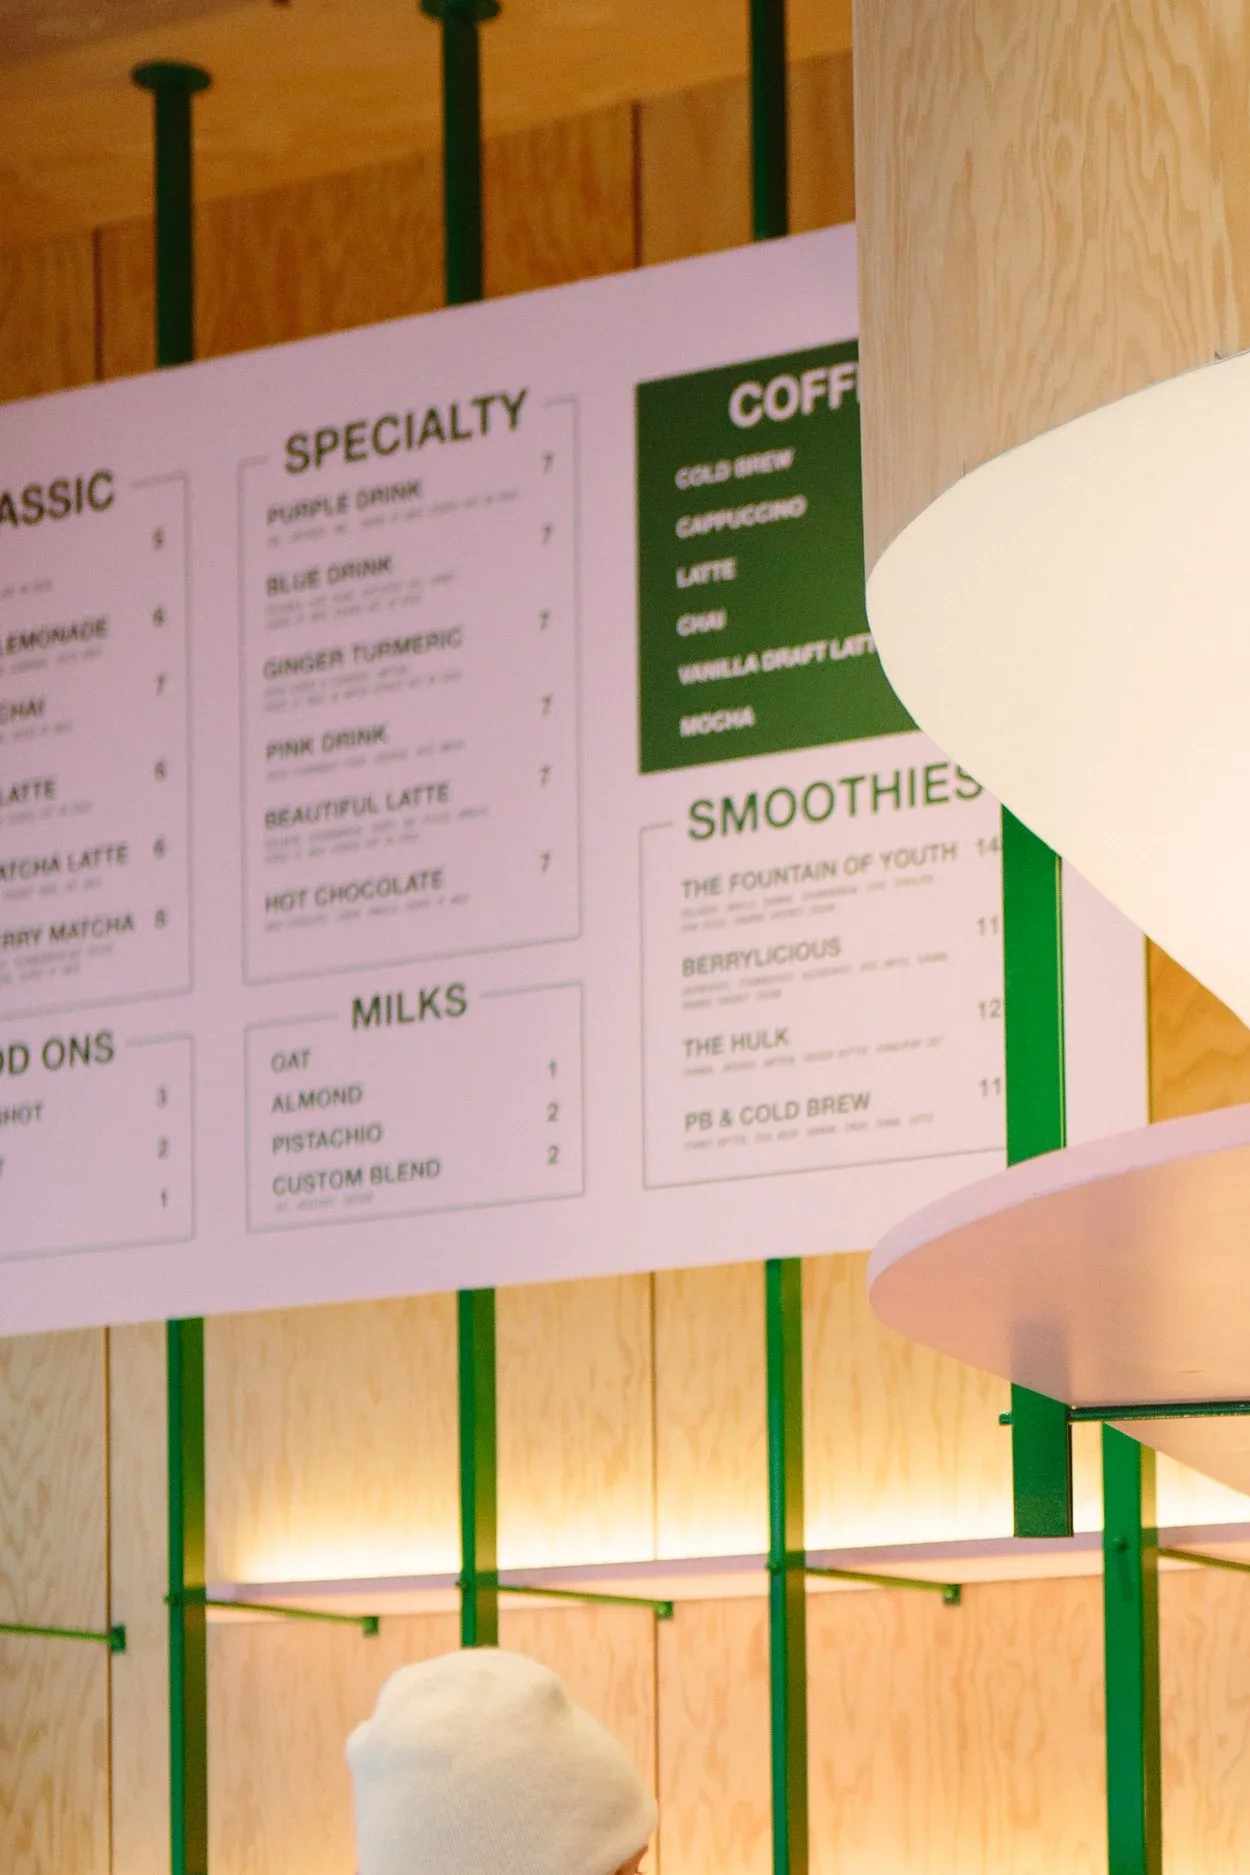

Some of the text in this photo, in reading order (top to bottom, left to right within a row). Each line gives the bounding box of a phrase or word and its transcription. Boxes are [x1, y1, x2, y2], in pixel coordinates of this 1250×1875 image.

[729, 361, 860, 428] COFF
[284, 386, 528, 474] SPECIALTY
[266, 492, 348, 526] PURPLE
[355, 477, 422, 510] DRINK
[541, 451, 553, 475] 7
[675, 447, 795, 490] COLD BREW
[675, 495, 808, 539] CAPPUCCINO
[266, 521, 552, 598] BLUE DRINK 7
[676, 556, 736, 589] LATTE
[0, 613, 108, 655] EMONADE
[263, 608, 551, 681] GINGER TURMERIC 7
[676, 608, 727, 637] CHAI
[156, 672, 166, 695] 7
[678, 652, 759, 686] VANILLA
[761, 639, 828, 672] DRAFT
[266, 736, 314, 761] PINK
[321, 722, 388, 752] DRINK
[541, 694, 552, 717] 7
[680, 705, 756, 738] MOCHA
[264, 764, 552, 831] BEAUTIFUL LATTE 7
[687, 761, 984, 841] SMOOTHIES
[66, 841, 128, 873] LATTE
[265, 887, 308, 914] HOT
[314, 868, 444, 908] CHOCOLATE
[540, 850, 551, 874] 7
[682, 836, 1001, 899] THE FOUNTAIN OF YOUTH 14
[48, 912, 135, 943] MATCHA
[682, 915, 999, 978] BERRYLICIOUS 11
[352, 981, 468, 1030] MILKS
[682, 1034, 722, 1058] THE
[731, 1027, 789, 1052] HULK
[977, 998, 1002, 1020] 12
[0, 1028, 115, 1077] D ONS
[271, 1048, 311, 1073] OAT
[271, 1058, 557, 1115] ALMOND 1
[684, 1107, 713, 1131] PB
[719, 1106, 733, 1128] &
[740, 1099, 799, 1126] COLD
[806, 1090, 870, 1117] BREW
[978, 1077, 1001, 1098] 11
[272, 1103, 559, 1154] PISTACHIO 2
[272, 1145, 560, 1196] CUSTOM BLEND 2
